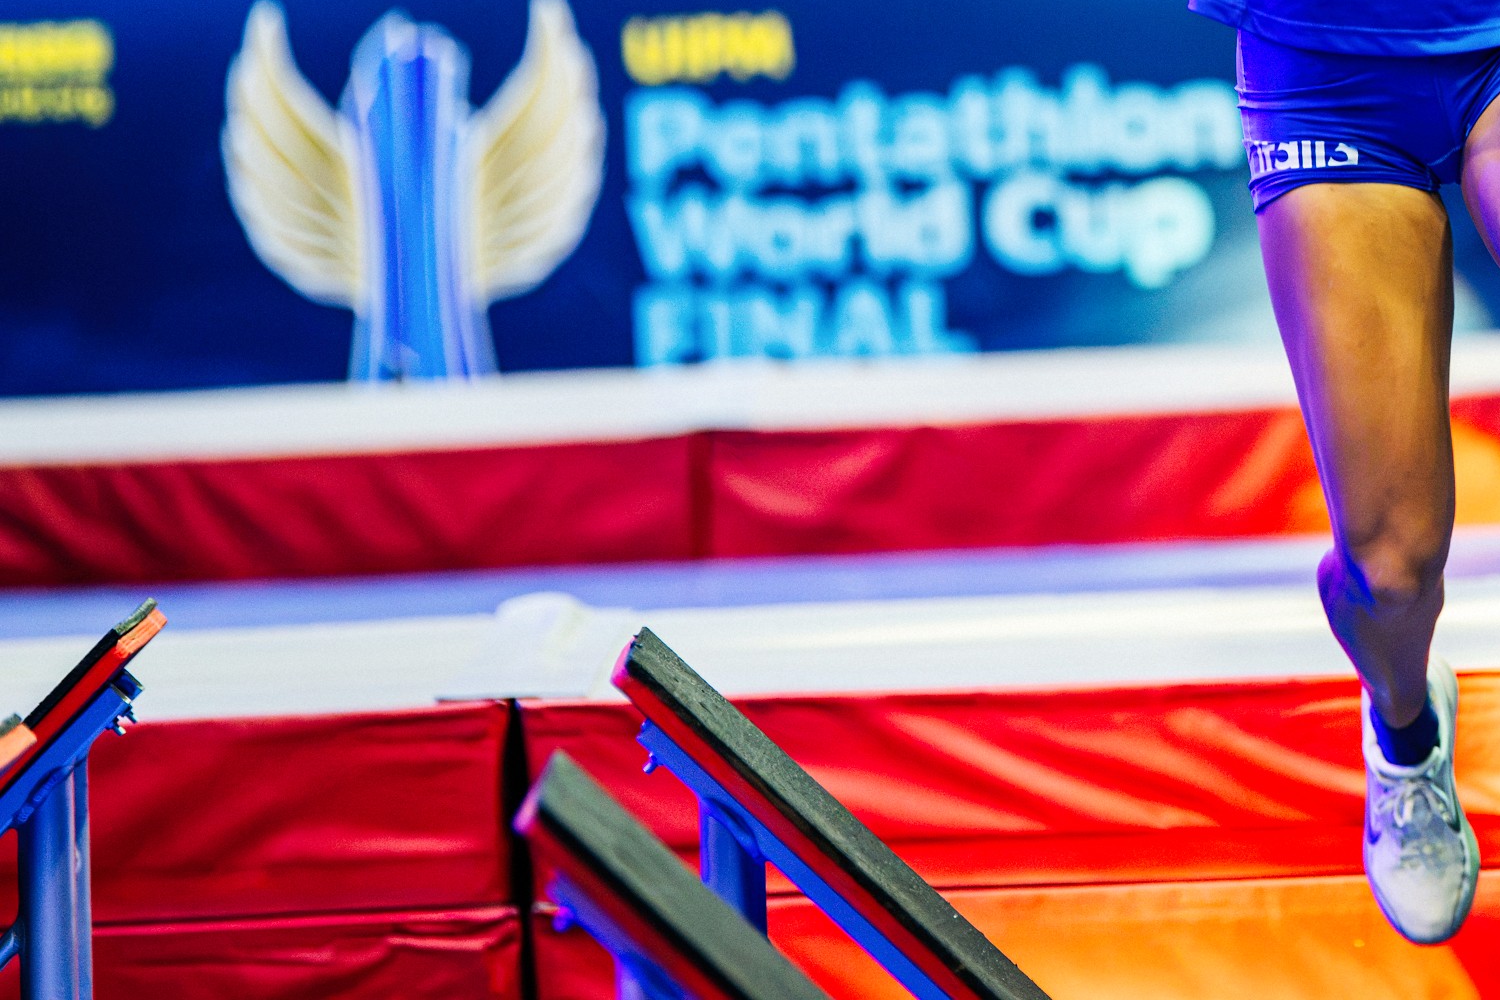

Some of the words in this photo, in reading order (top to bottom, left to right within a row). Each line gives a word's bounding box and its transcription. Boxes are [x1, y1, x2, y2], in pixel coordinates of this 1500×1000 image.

[625, 64, 1246, 188] Pentathlon
[625, 174, 978, 278] World
[982, 174, 1216, 290] Cup
